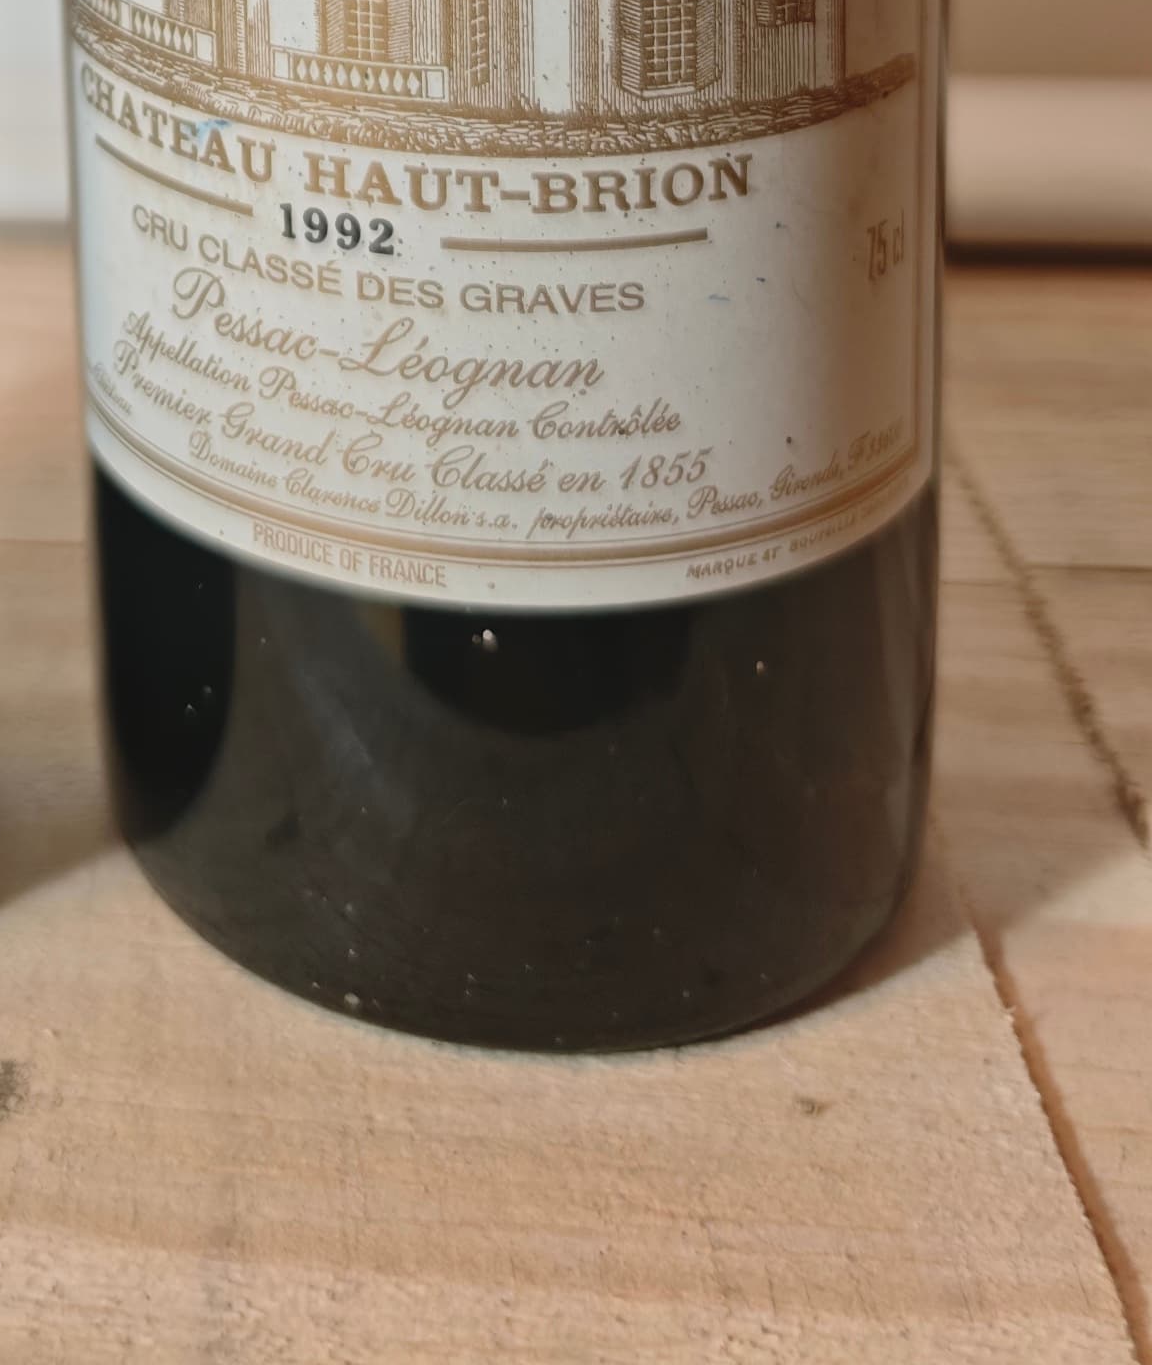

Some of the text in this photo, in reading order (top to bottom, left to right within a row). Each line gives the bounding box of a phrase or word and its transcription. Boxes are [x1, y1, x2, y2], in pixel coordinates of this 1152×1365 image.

[80, 63, 277, 184] CHATEAU
[302, 150, 754, 214] HAUT-BRION
[131, 202, 646, 315] CRU CLASSÉ DES GRAVES
[279, 202, 395, 255] 1992
[121, 309, 682, 448] Appellation Pessac-Léognan Contrôlée
[170, 267, 606, 410] Pessac-Léognan
[112, 339, 714, 495] Premier Grand Cru Classé en 1855
[187, 429, 279, 488] Domaine
[283, 467, 382, 513] Clarence
[383, 486, 470, 526] Dillon
[251, 521, 449, 588] PRODUCE OF FRANCE
